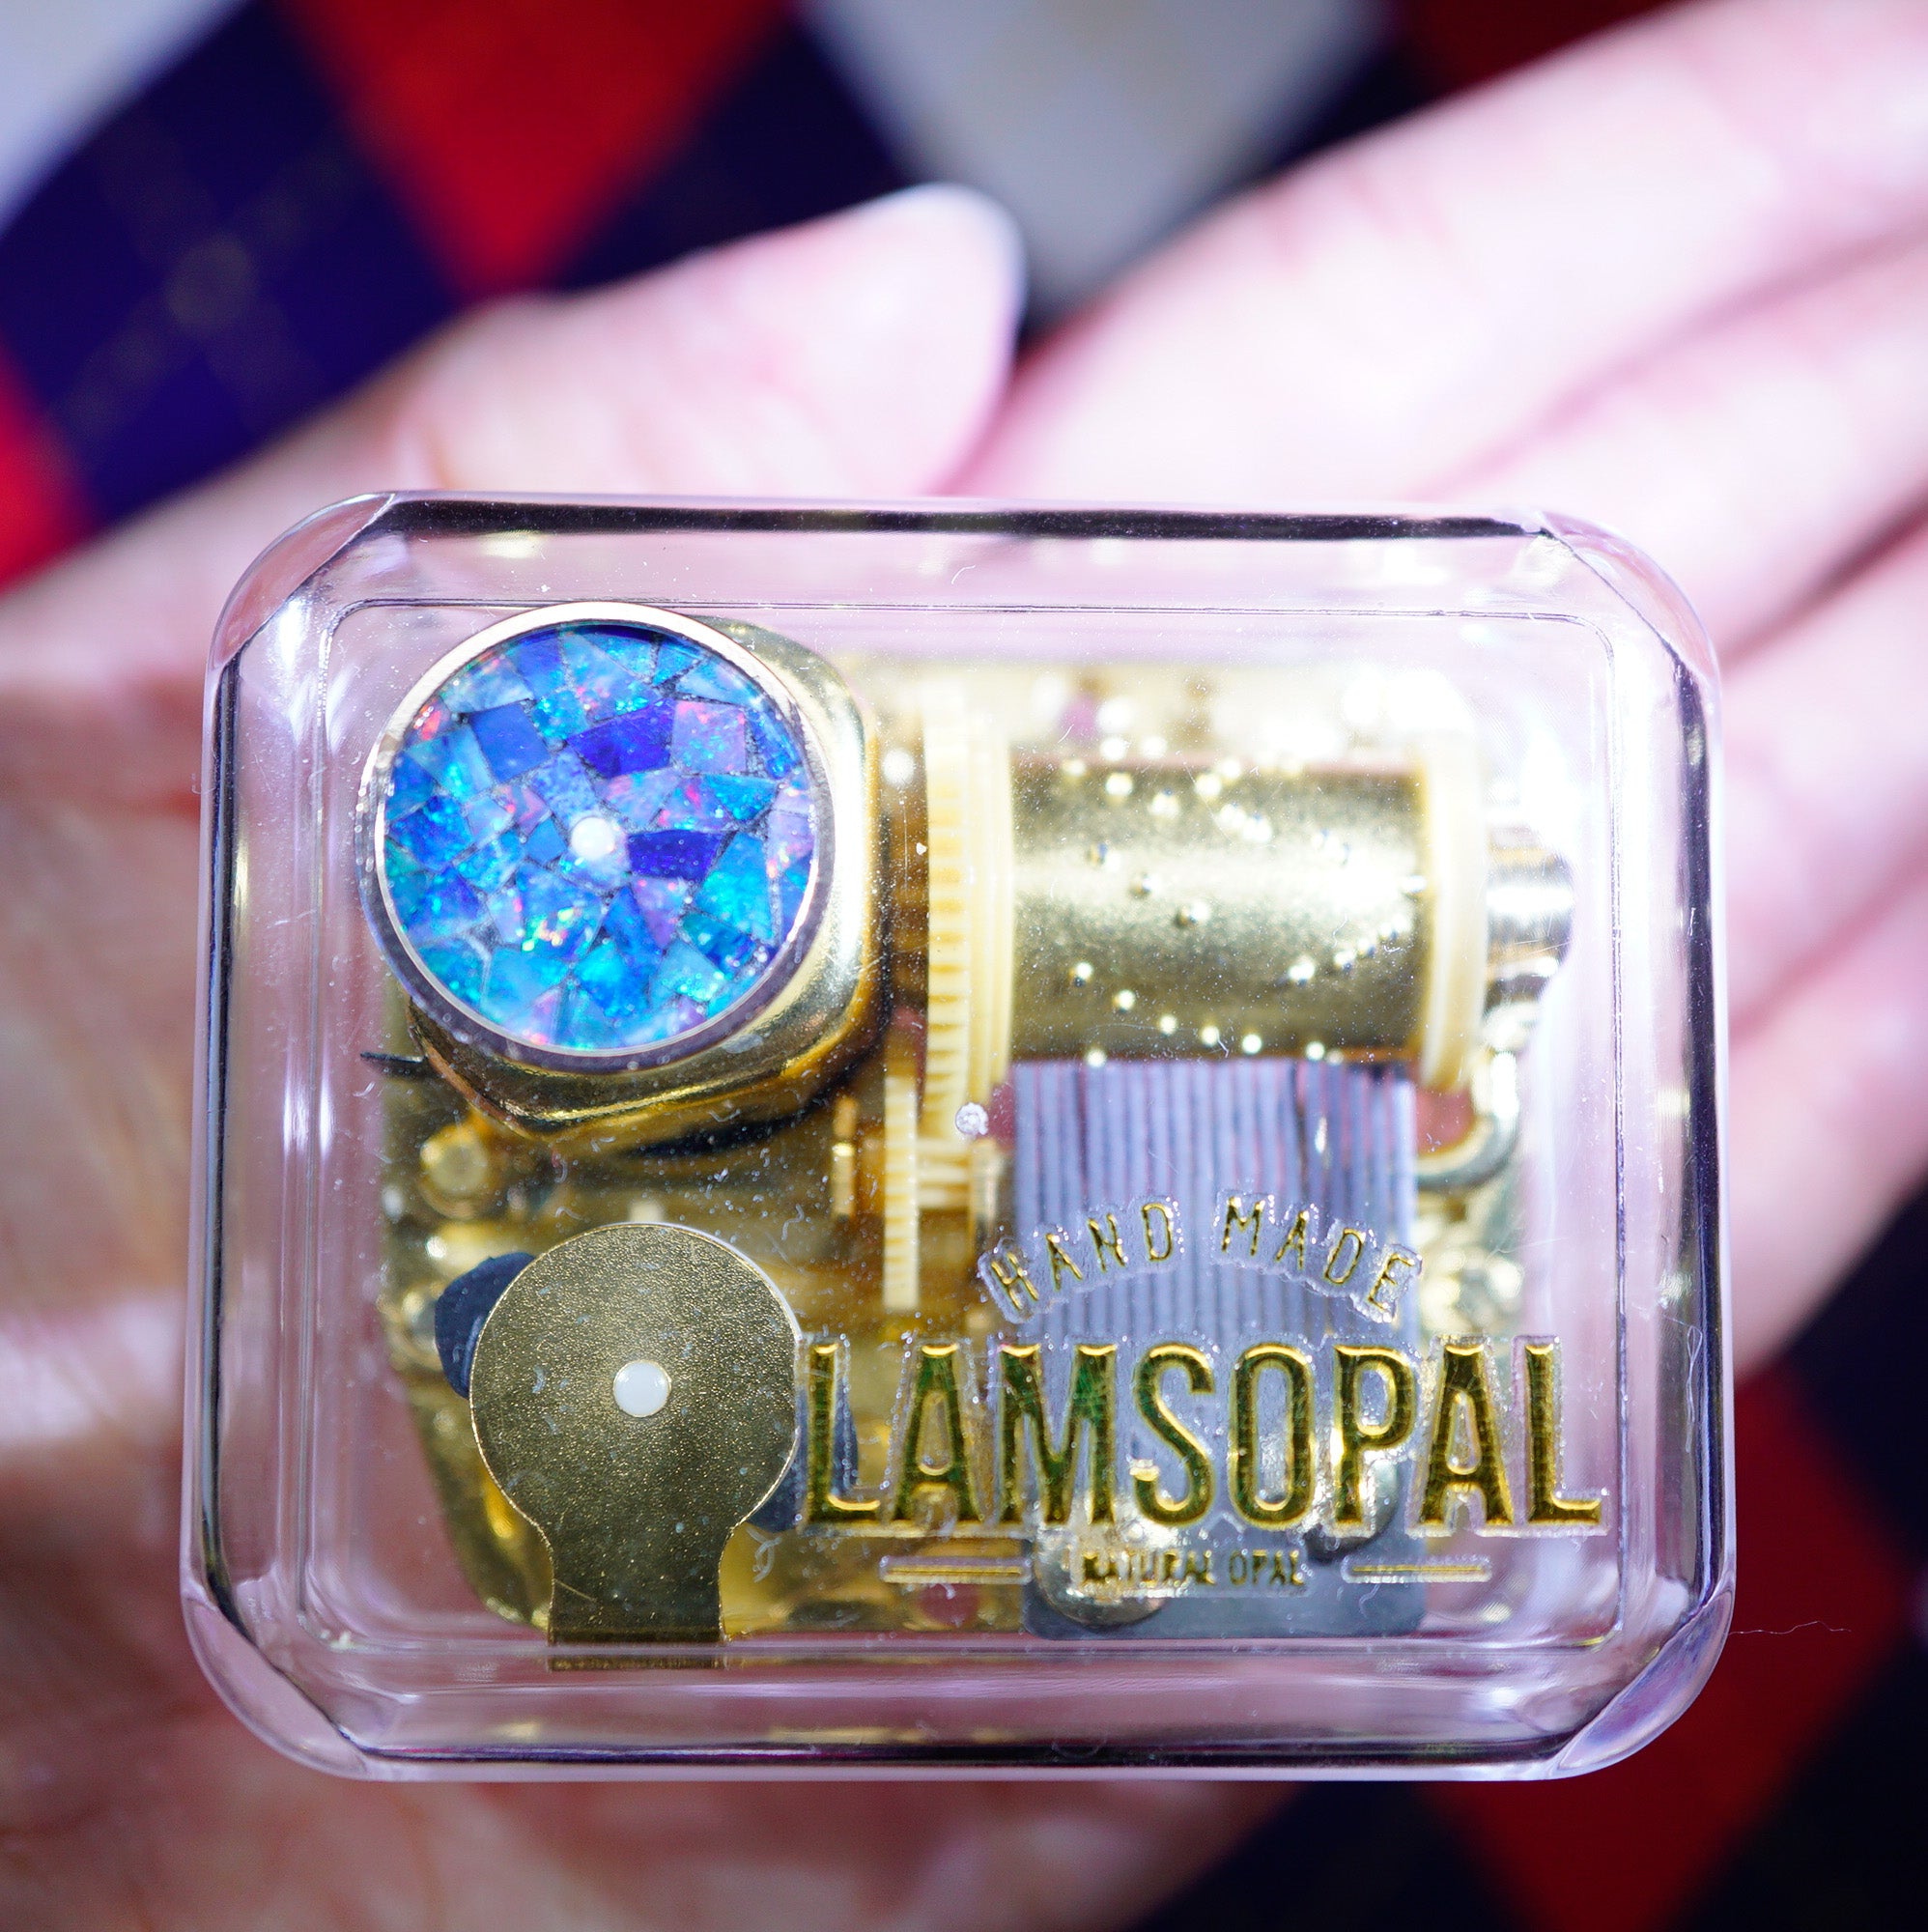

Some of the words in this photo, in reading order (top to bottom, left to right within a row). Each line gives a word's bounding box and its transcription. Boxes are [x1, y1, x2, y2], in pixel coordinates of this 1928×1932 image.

[989, 1201, 1175, 1311] HAND
[1220, 1196, 1415, 1311] MADE
[805, 1343, 1602, 1528] LAMSOPAL
[1228, 1548, 1304, 1585] OPAL
